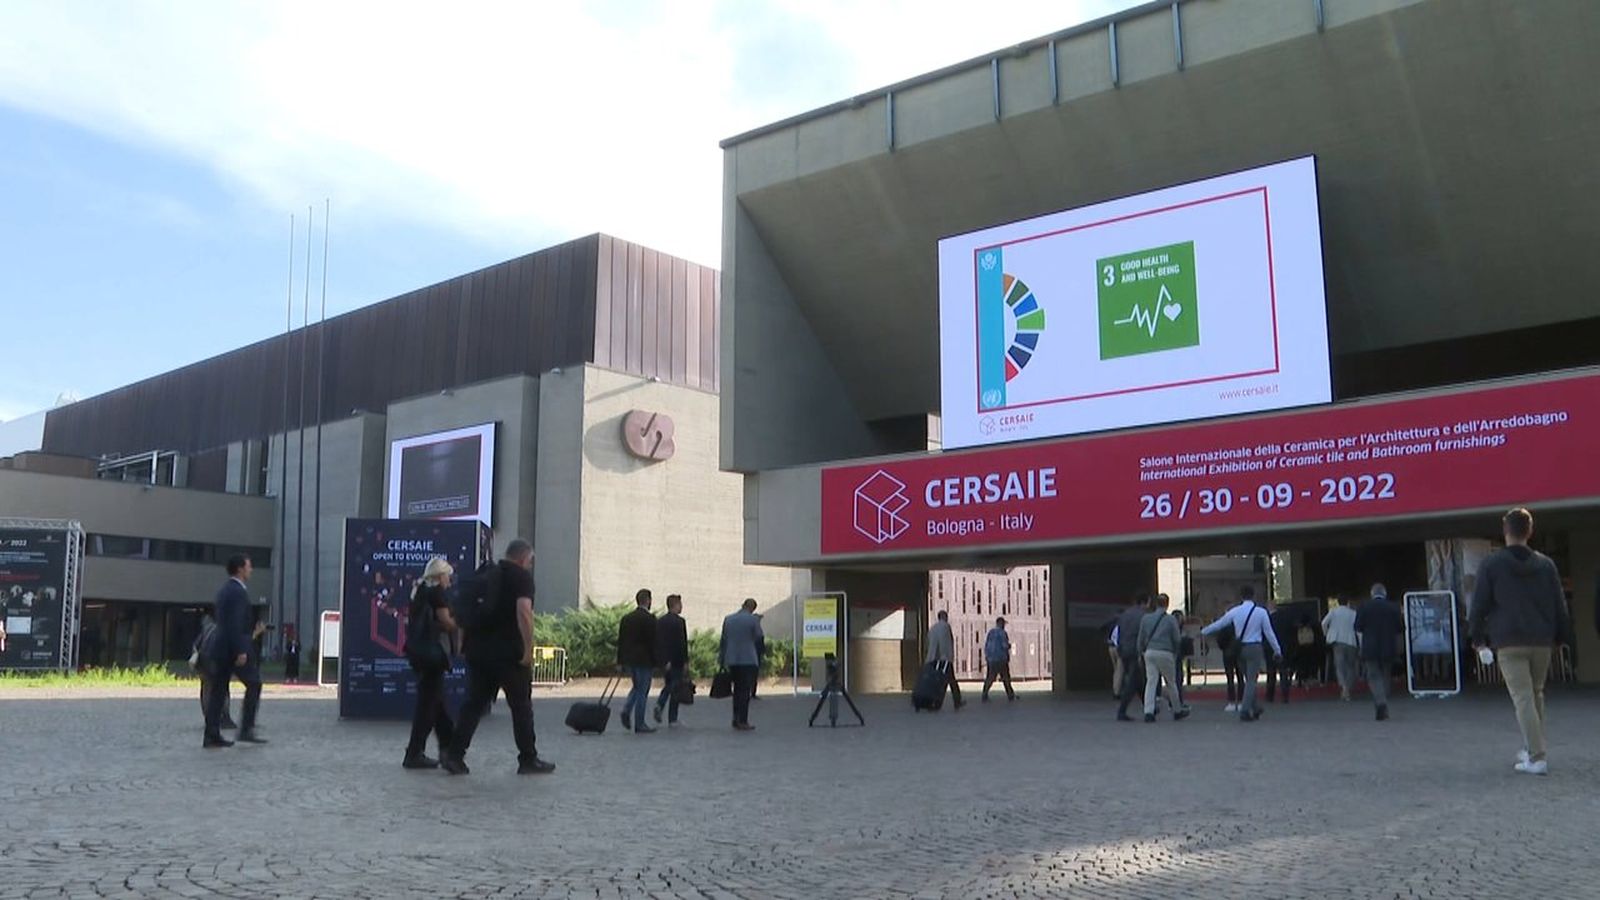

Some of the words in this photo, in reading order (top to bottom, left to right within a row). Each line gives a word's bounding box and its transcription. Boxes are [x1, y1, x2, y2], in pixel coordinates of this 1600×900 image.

[1103, 265, 1115, 287] 3
[1120, 260, 1141, 272] GOOD
[1142, 253, 1169, 267] HEALTH
[1121, 272, 1136, 283] AND
[1137, 264, 1180, 281] WELL-BEING
[1218, 384, 1279, 400] www.cersaie.it
[1000, 413, 1034, 426] CERSAIE
[1140, 456, 1174, 468] Salone
[1176, 447, 1251, 465] Internazionale
[1254, 445, 1281, 457] della
[1284, 438, 1335, 453] Ceramica
[1338, 436, 1357, 450] per
[1361, 426, 1440, 445] l'Architettura
[1443, 425, 1451, 435] e
[1453, 411, 1568, 433] dell'Arredobagno
[1140, 466, 1206, 481] International
[1209, 459, 1263, 475] Exhibition
[1265, 456, 1277, 470] of
[1280, 453, 1324, 468] Ceramic
[1326, 450, 1345, 463] tile
[1347, 447, 1369, 461] and
[1373, 442, 1432, 459] Bathroom
[1435, 433, 1506, 452] furnishings
[924, 467, 1057, 508] CERSAIE
[1140, 493, 1172, 519] 26
[1178, 490, 1192, 519] /
[1198, 488, 1232, 514] 30
[1257, 482, 1293, 509] 09
[1320, 473, 1395, 504] 2022
[927, 518, 985, 536] Bologna
[1000, 513, 1034, 532] Italy
[387, 540, 433, 551] CERSAIE
[805, 624, 834, 633] CERSAIE
